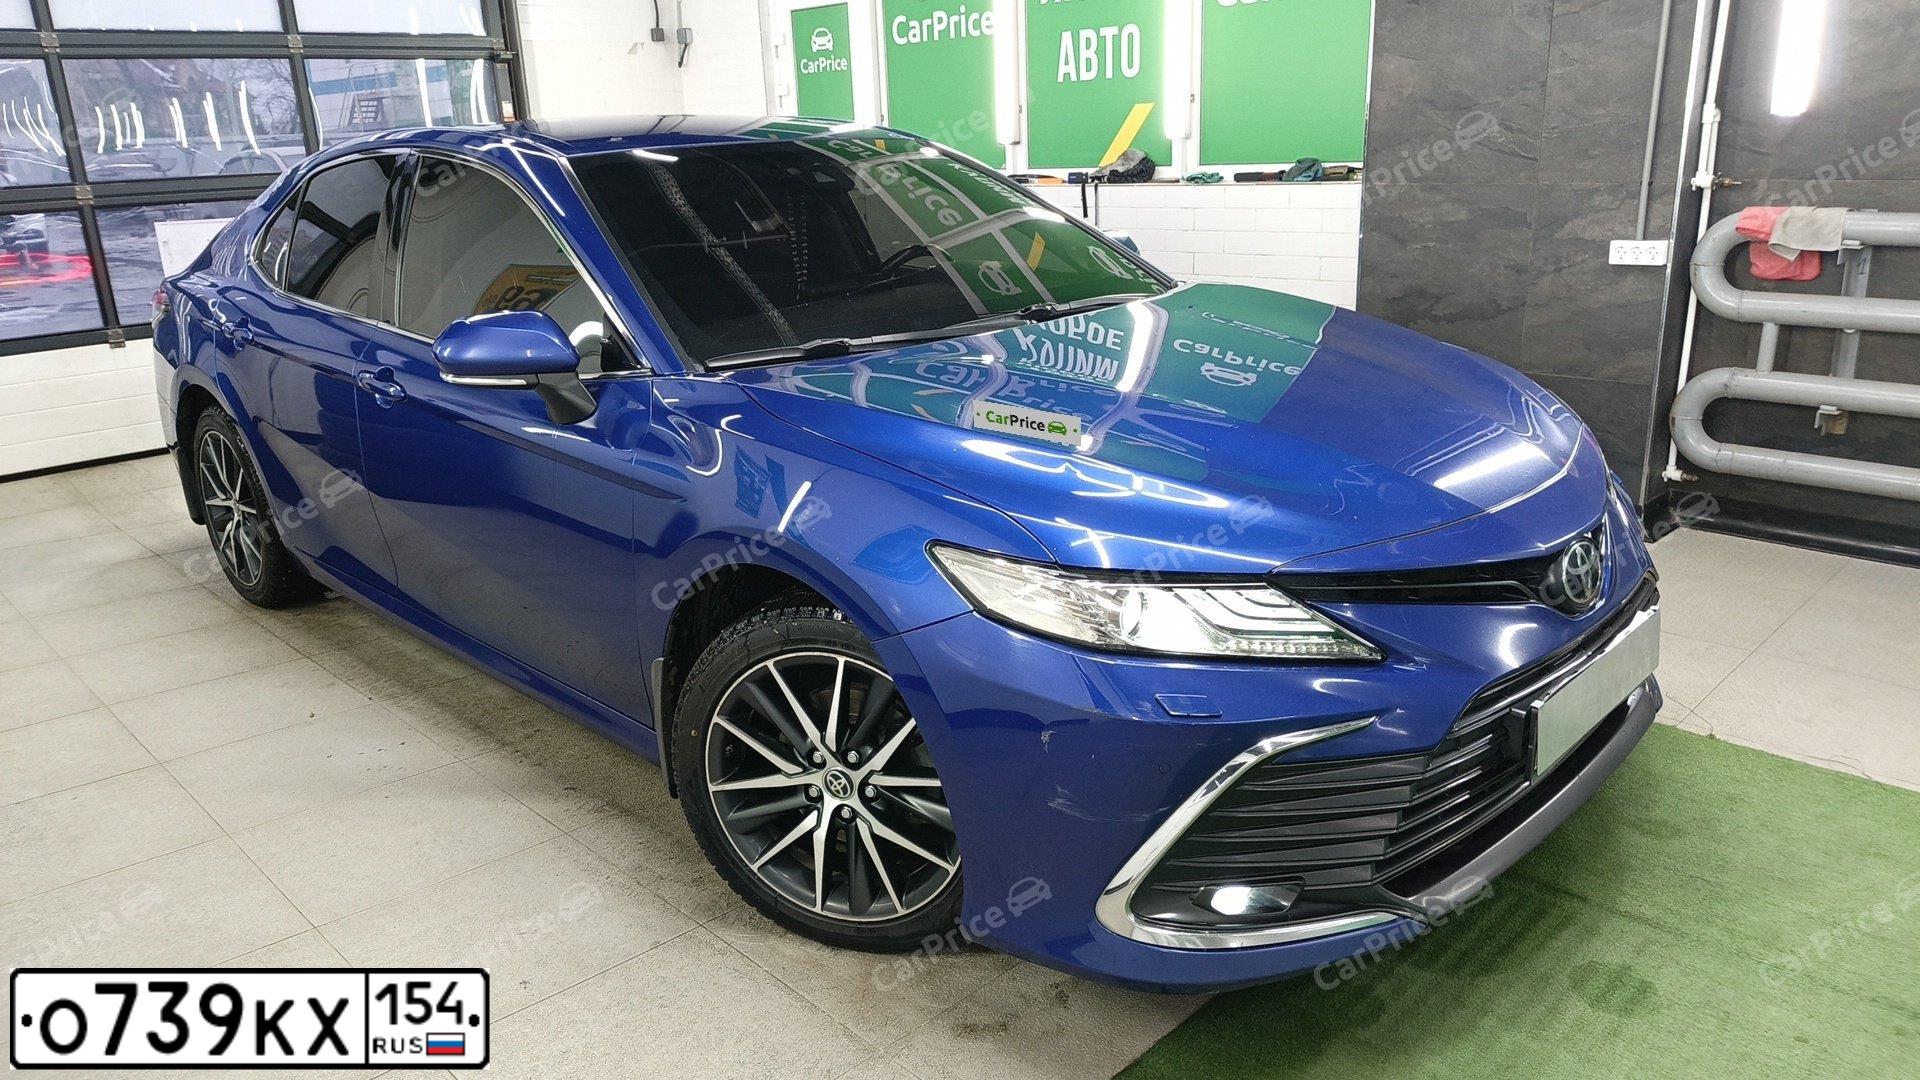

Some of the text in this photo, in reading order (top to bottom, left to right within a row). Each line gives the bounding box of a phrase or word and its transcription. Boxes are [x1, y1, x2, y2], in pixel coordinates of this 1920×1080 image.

[892, 5, 994, 45] CarPrice
[800, 55, 848, 74] CarPrice
[1057, 24, 1141, 83] АВТО
